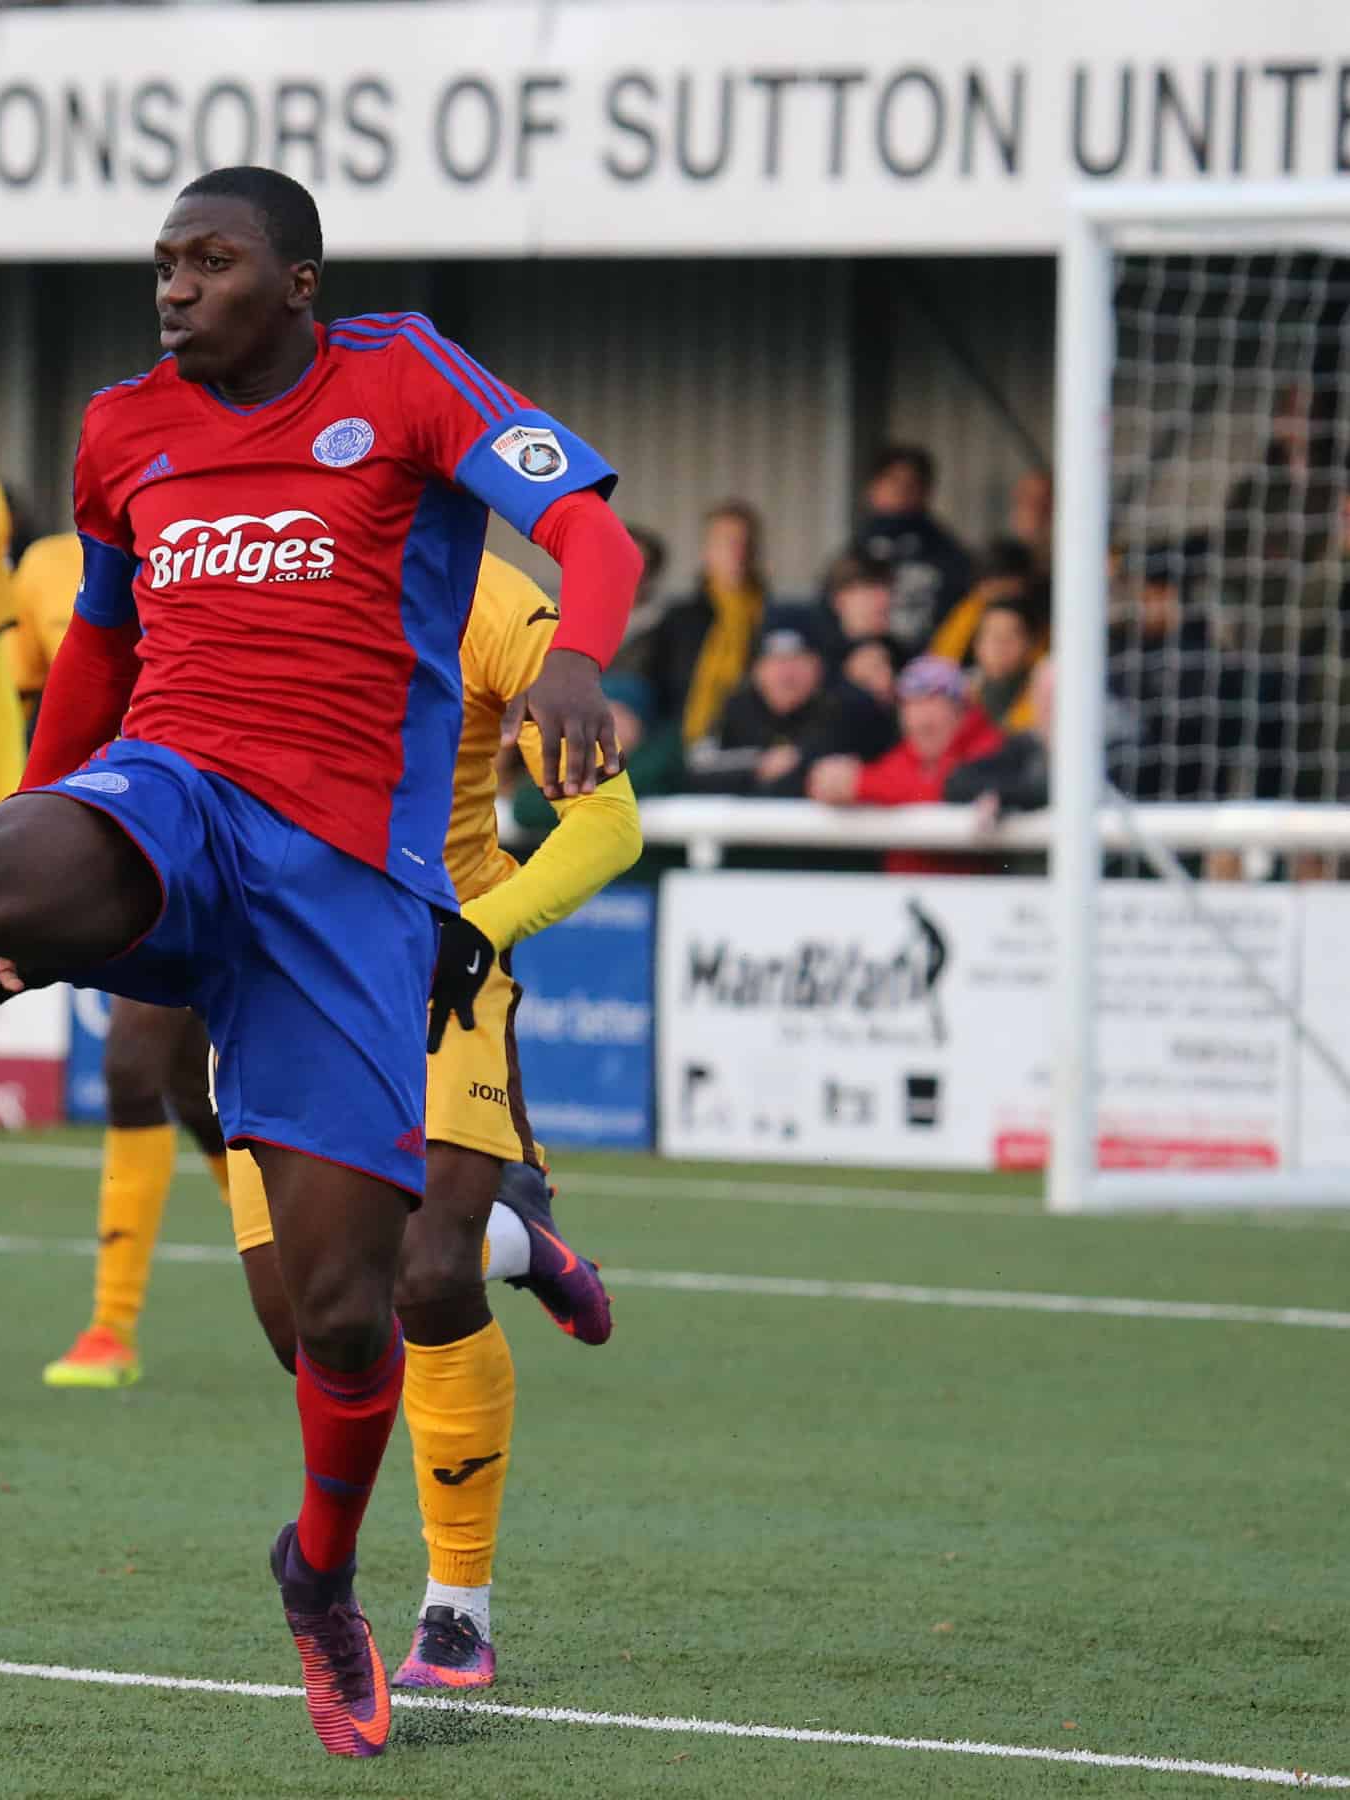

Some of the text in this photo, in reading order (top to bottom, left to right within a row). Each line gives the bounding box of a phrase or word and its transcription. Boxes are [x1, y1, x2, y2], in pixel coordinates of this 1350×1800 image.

[435, 72, 567, 184] OF
[602, 68, 1028, 183] SUTTON
[149, 530, 336, 589] Bridges
[268, 568, 333, 583] .co.uk
[468, 1081, 508, 1107] JOM
